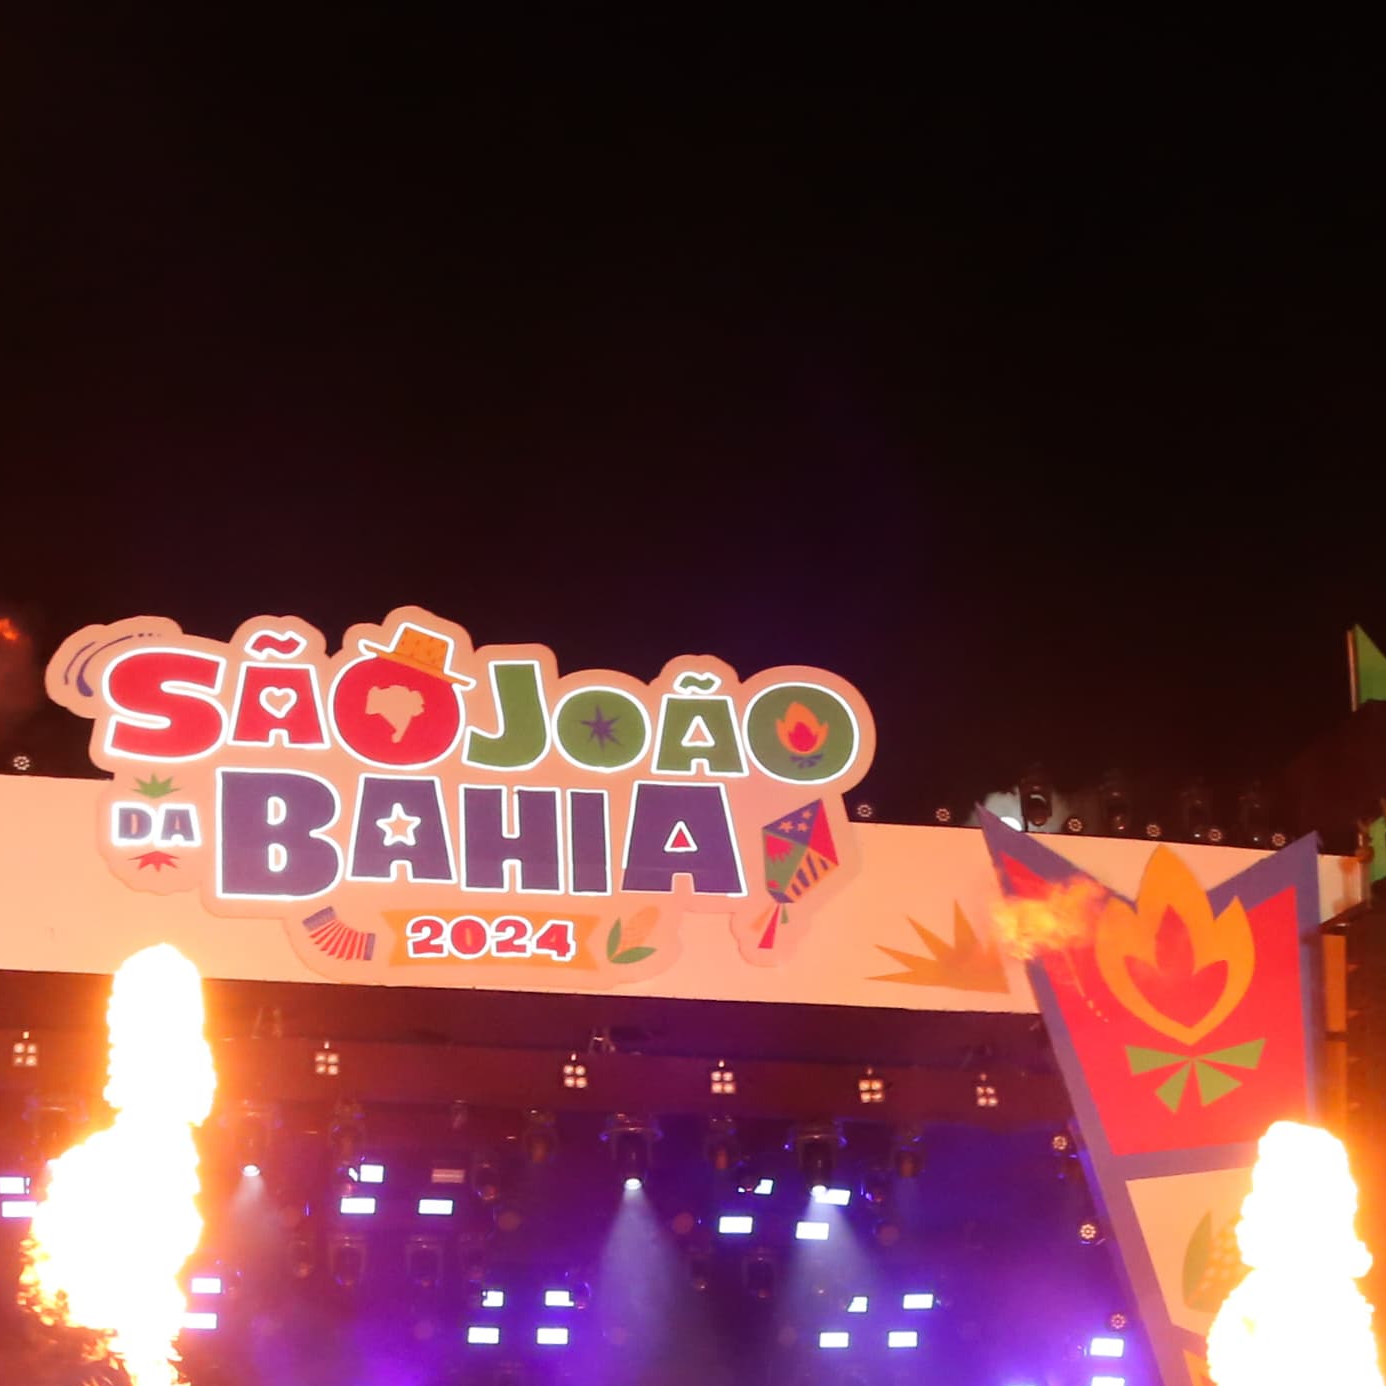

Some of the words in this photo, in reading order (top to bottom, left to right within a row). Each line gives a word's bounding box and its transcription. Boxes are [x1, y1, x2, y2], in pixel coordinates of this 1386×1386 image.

[104, 628, 461, 769] SÃO
[463, 661, 858, 784] JOÃO
[111, 801, 202, 847] DA
[215, 767, 748, 900] BAHIA
[407, 914, 580, 961] 2024
